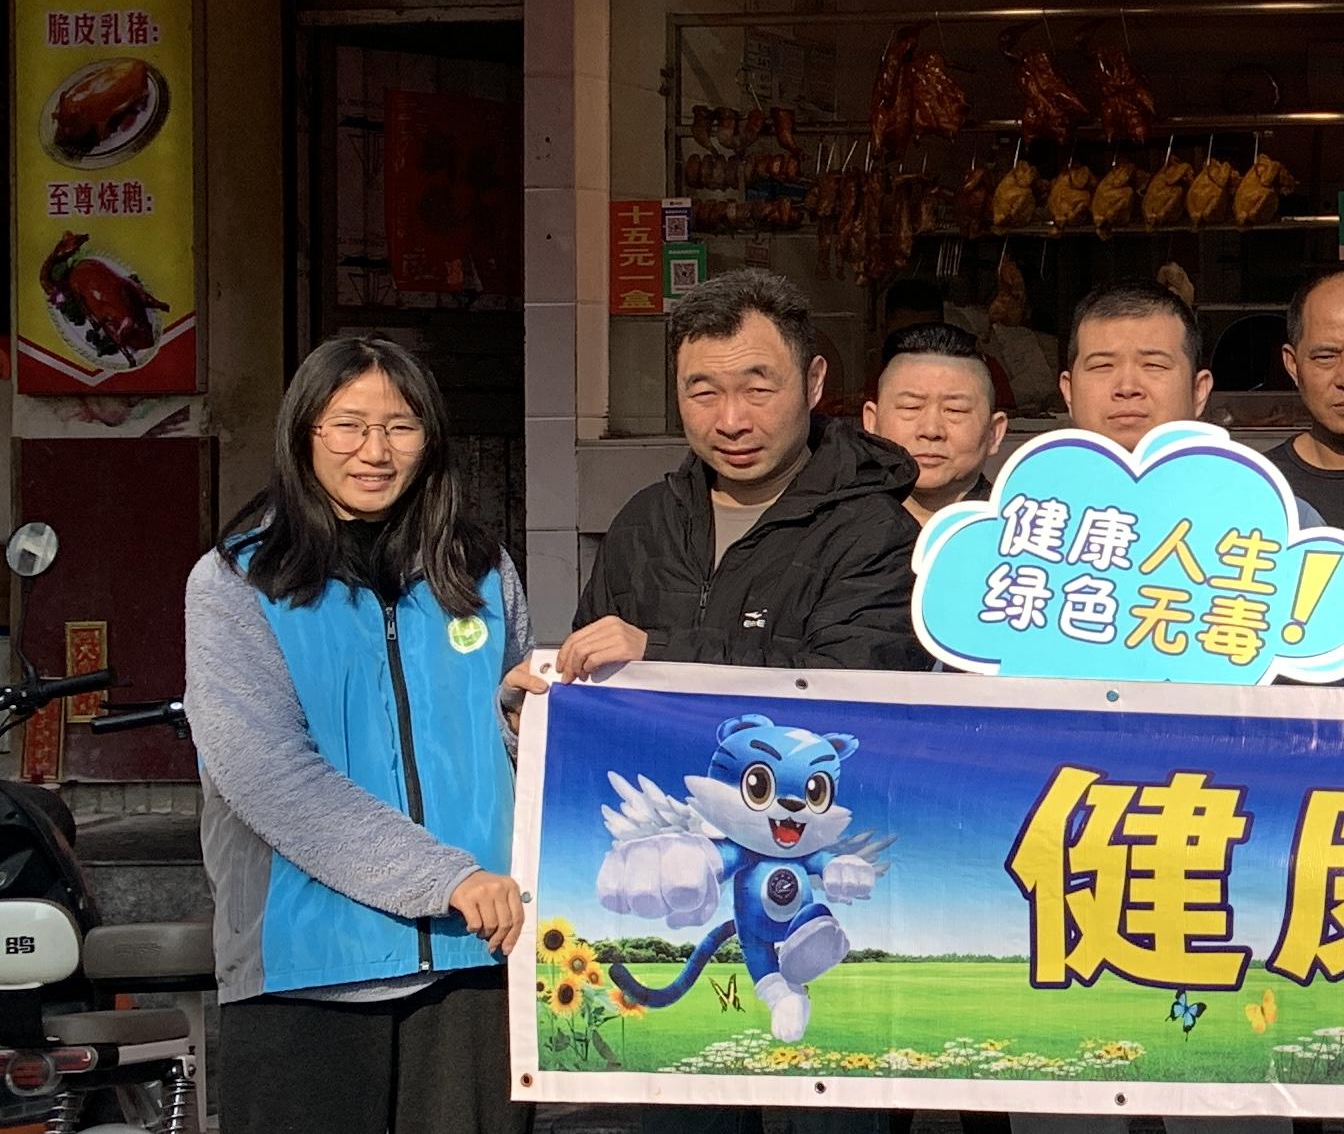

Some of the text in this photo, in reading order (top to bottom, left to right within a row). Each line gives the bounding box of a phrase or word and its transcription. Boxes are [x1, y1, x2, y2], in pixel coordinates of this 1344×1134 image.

[617, 205, 656, 309] 十五元一盒
[999, 494, 1281, 595] 健康人生
[978, 563, 1269, 666] 绿色无毒
